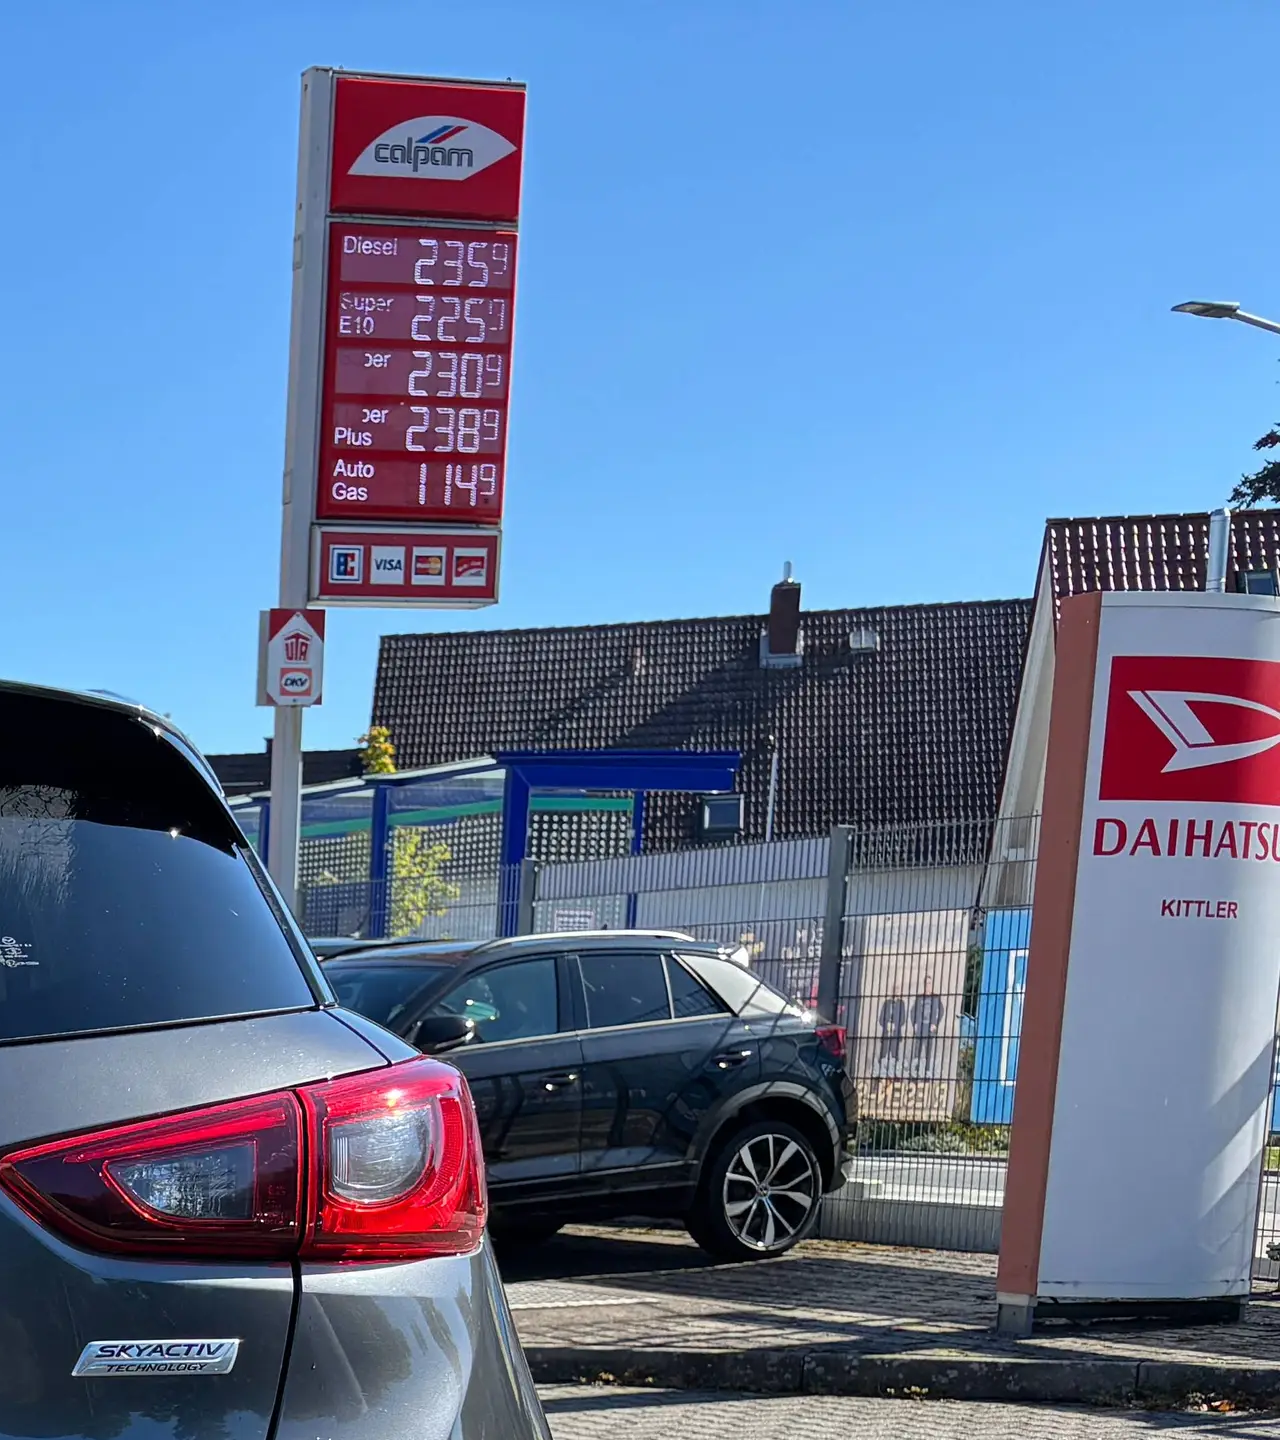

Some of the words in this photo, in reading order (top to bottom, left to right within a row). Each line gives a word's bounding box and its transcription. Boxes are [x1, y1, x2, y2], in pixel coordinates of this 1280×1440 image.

[373, 136, 474, 173] calpam
[343, 235, 398, 256] Diesel
[340, 292, 394, 315] Super
[339, 315, 375, 336] E10
[333, 426, 373, 446] Plus
[332, 459, 375, 479] Auto
[331, 482, 369, 501] Gas
[374, 557, 403, 572] VISA
[1160, 899, 1238, 919] KITTLER
[95, 1342, 226, 1358] SKYACTIV
[106, 1363, 208, 1373] TECHNOLOGY
